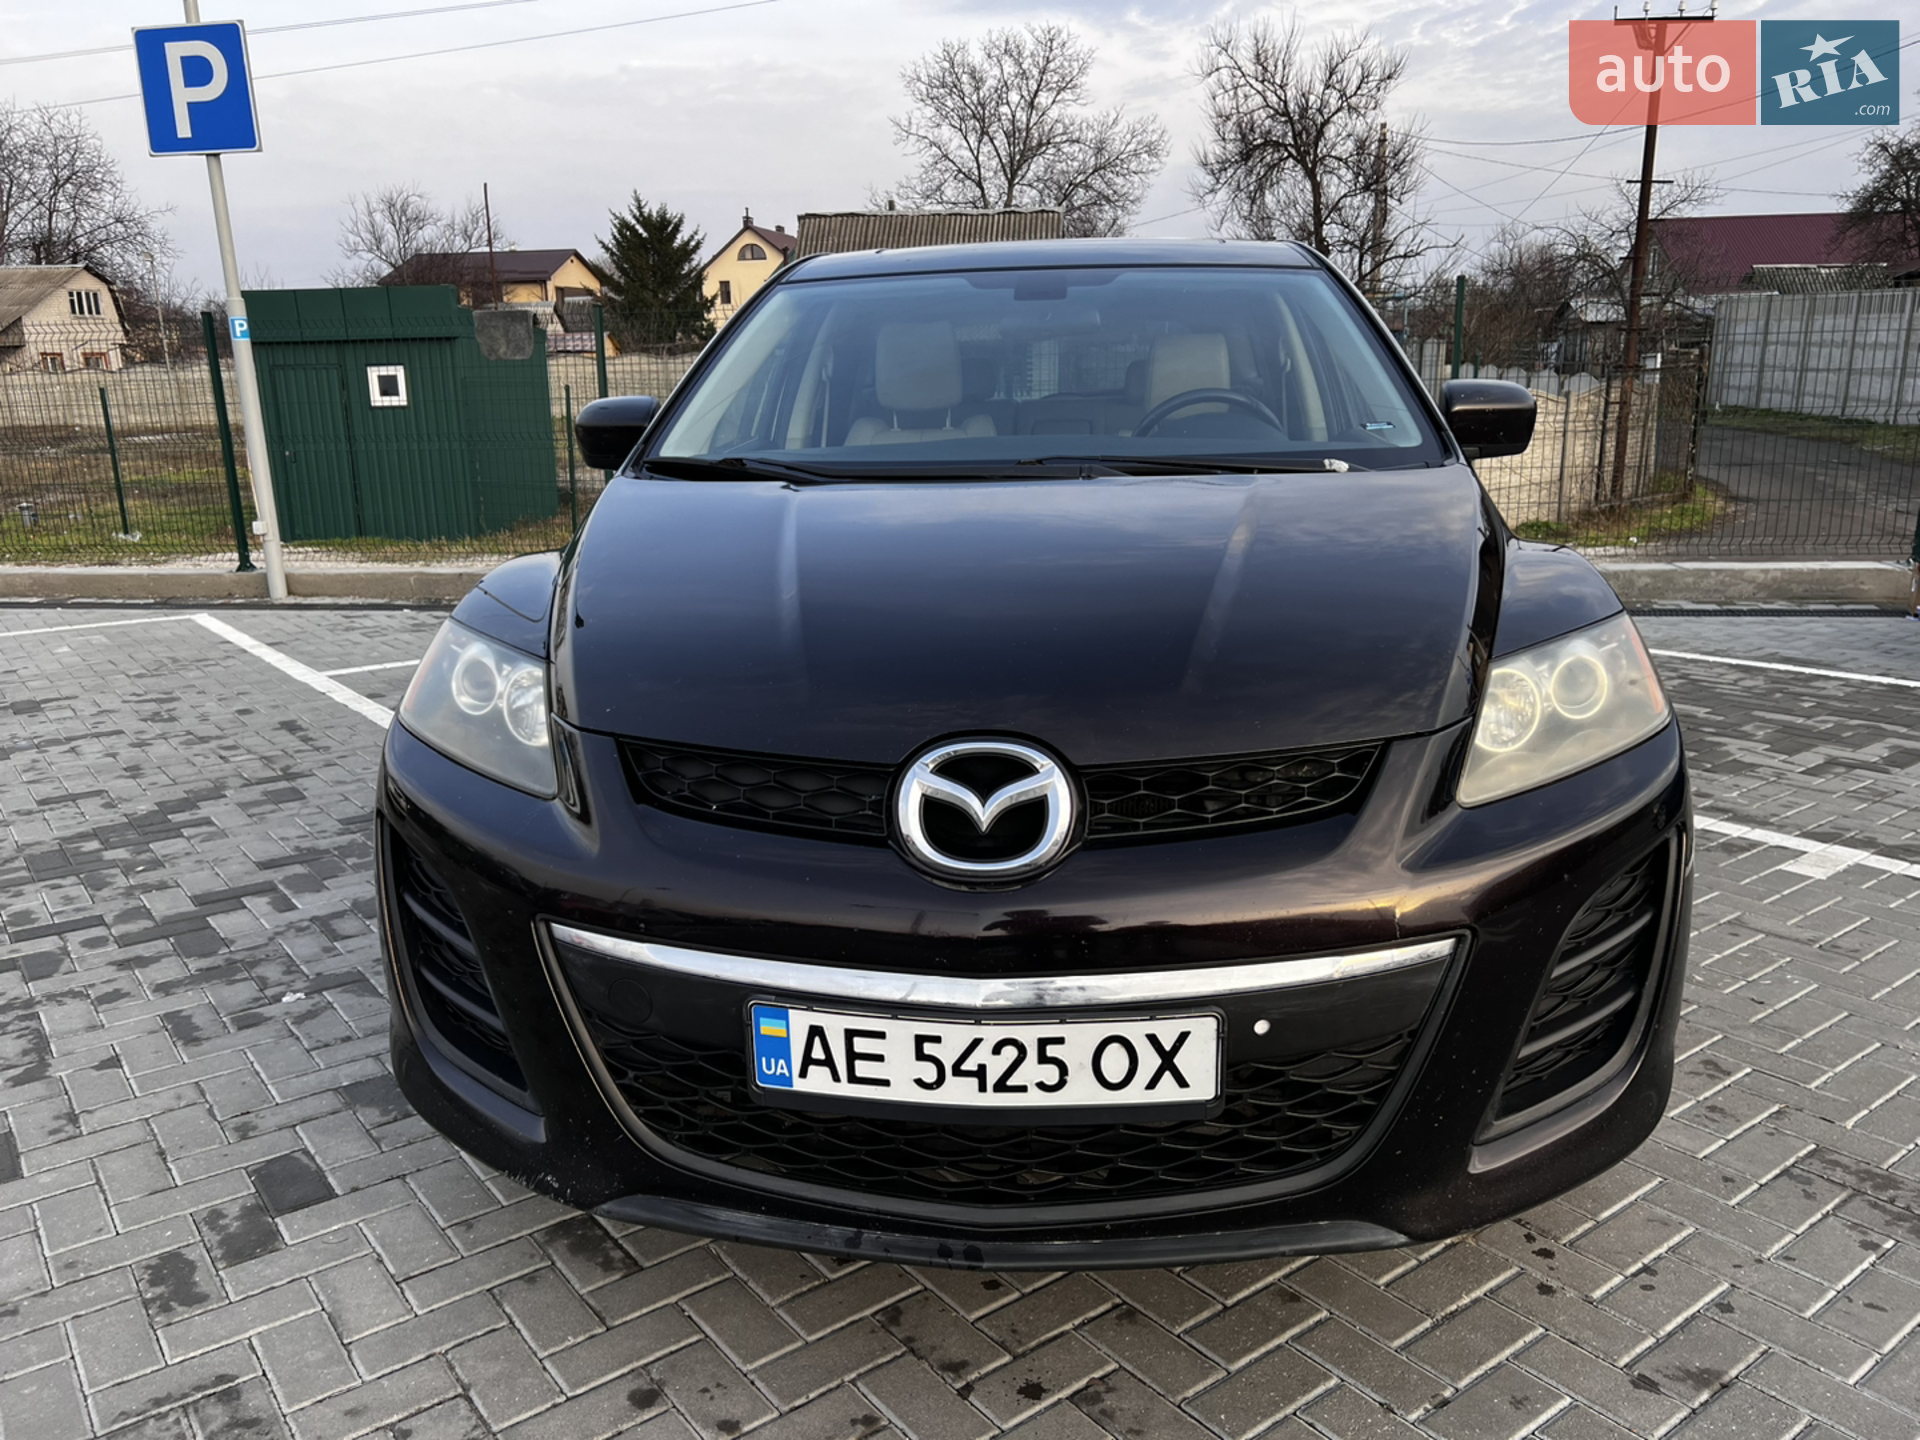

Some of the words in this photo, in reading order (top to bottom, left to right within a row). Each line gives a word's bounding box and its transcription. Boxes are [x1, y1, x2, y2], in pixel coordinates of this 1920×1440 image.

[163, 40, 228, 139] P
[234, 319, 248, 337] P
[761, 1056, 790, 1078] UA
[798, 1024, 892, 1087] AE
[913, 1033, 1069, 1094] 5425
[1091, 1030, 1191, 1092] OX
